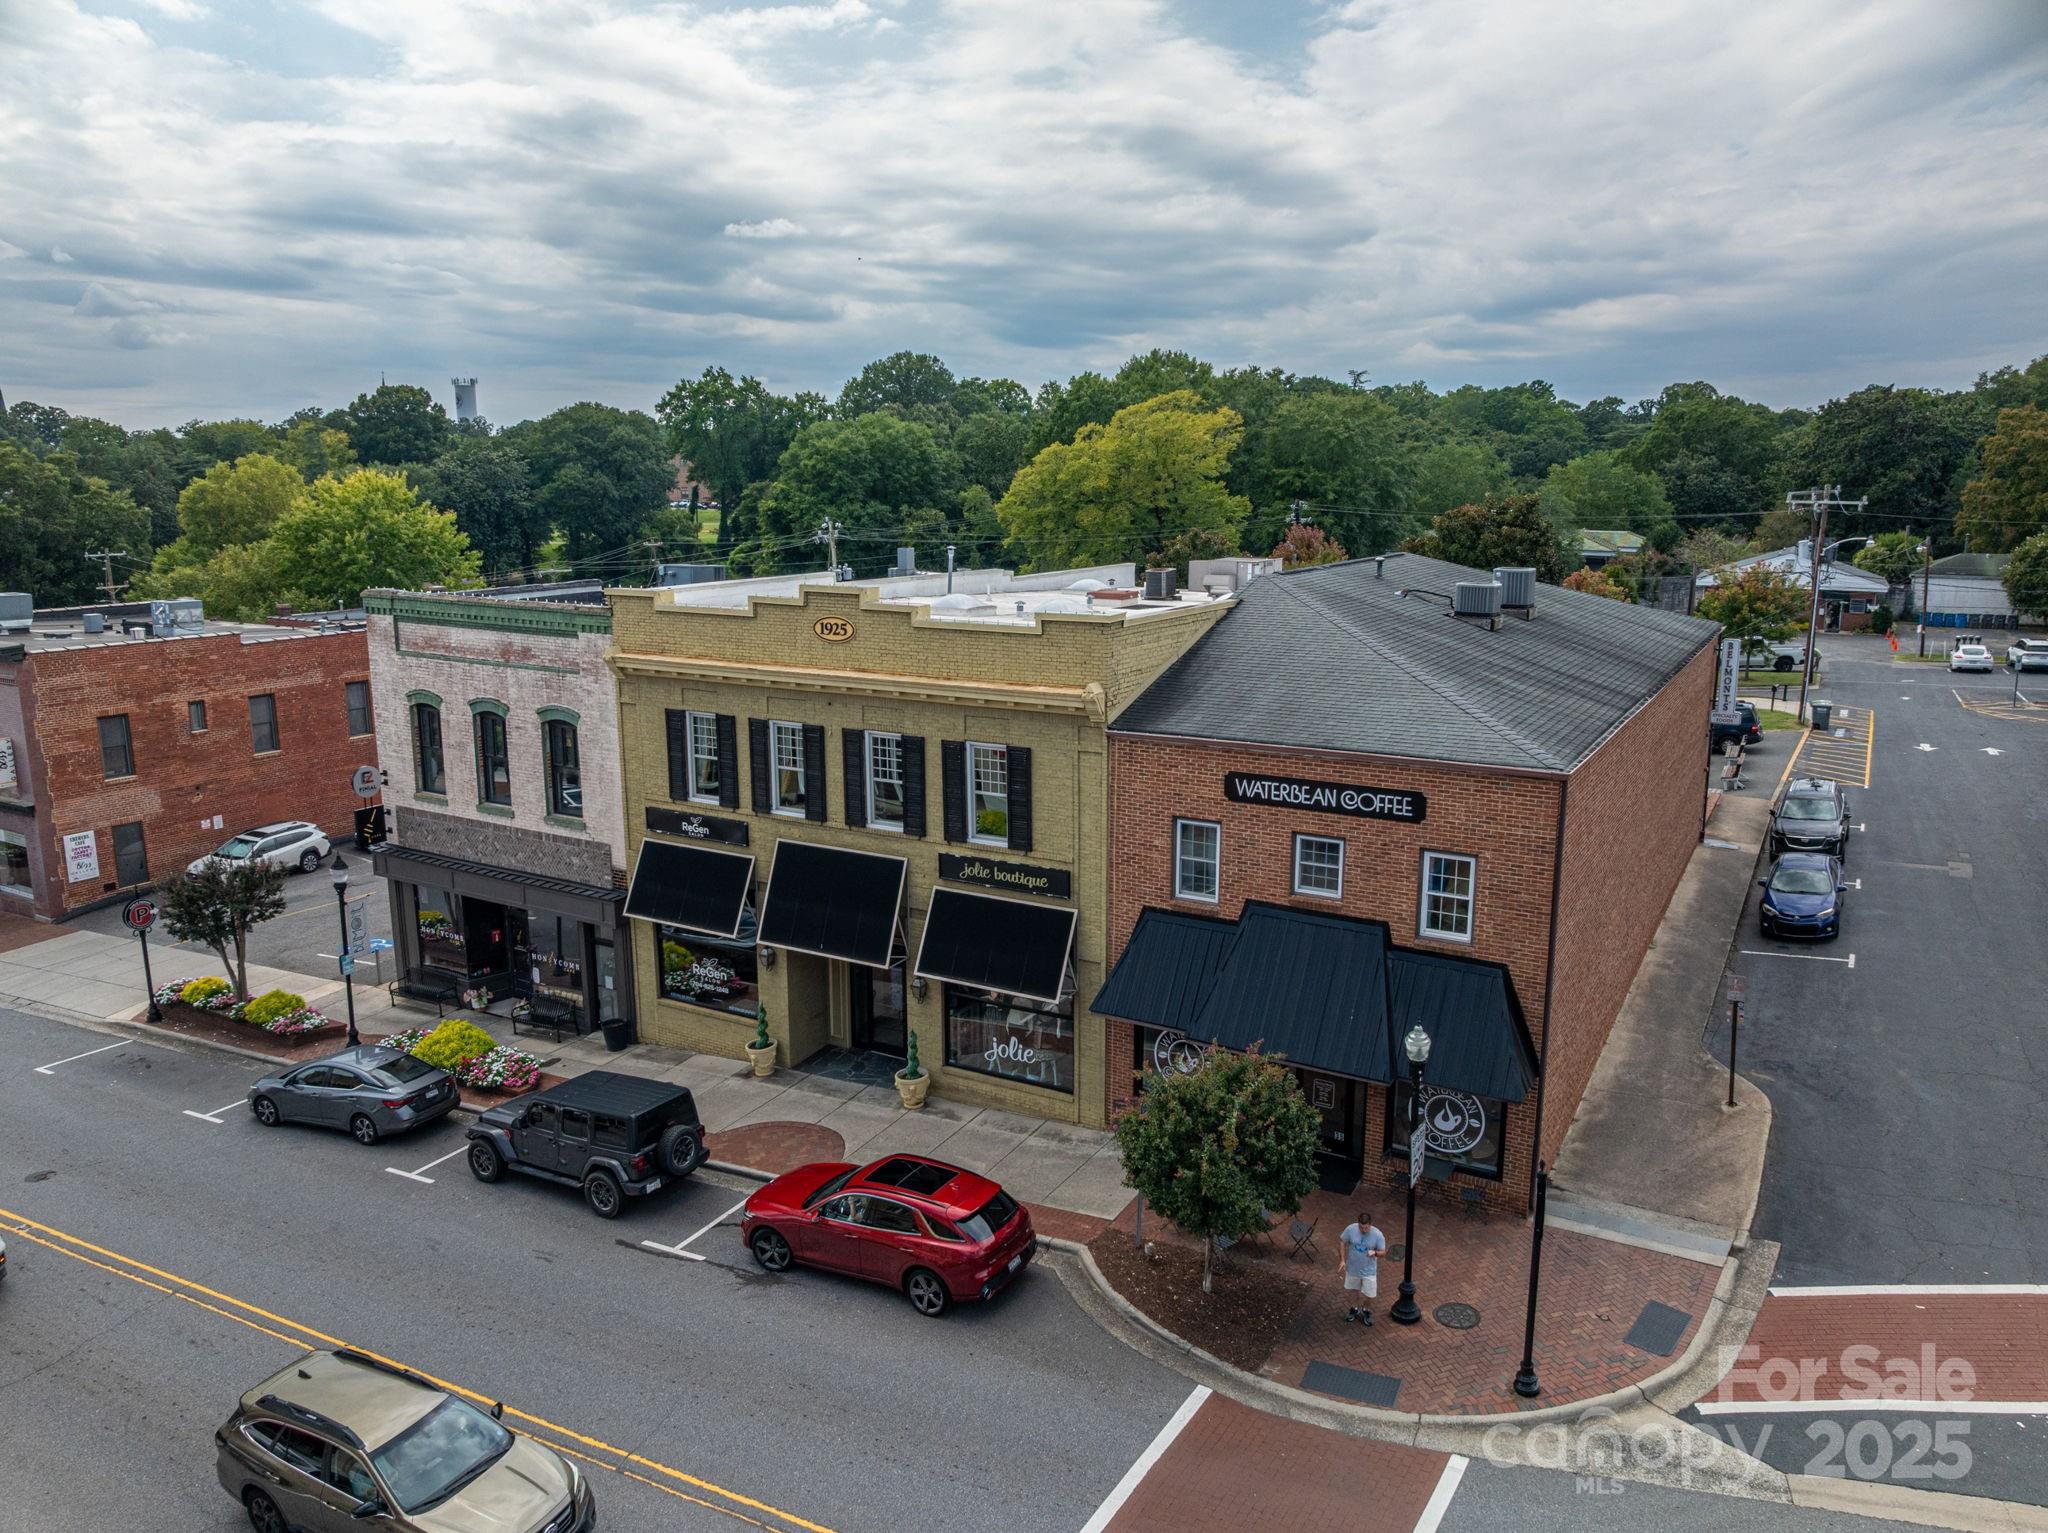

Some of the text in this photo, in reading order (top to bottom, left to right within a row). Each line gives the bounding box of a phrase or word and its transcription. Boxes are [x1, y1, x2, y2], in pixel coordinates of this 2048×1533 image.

[820, 621, 847, 636] 1925
[1235, 778, 1413, 816] WATERBEAN COFFEE
[682, 821, 710, 835] ReGen
[959, 862, 1048, 888] jolie boutique
[692, 963, 727, 981] ReGen
[984, 1036, 1036, 1064] jolie
[1425, 1122, 1473, 1149] OFFEE
